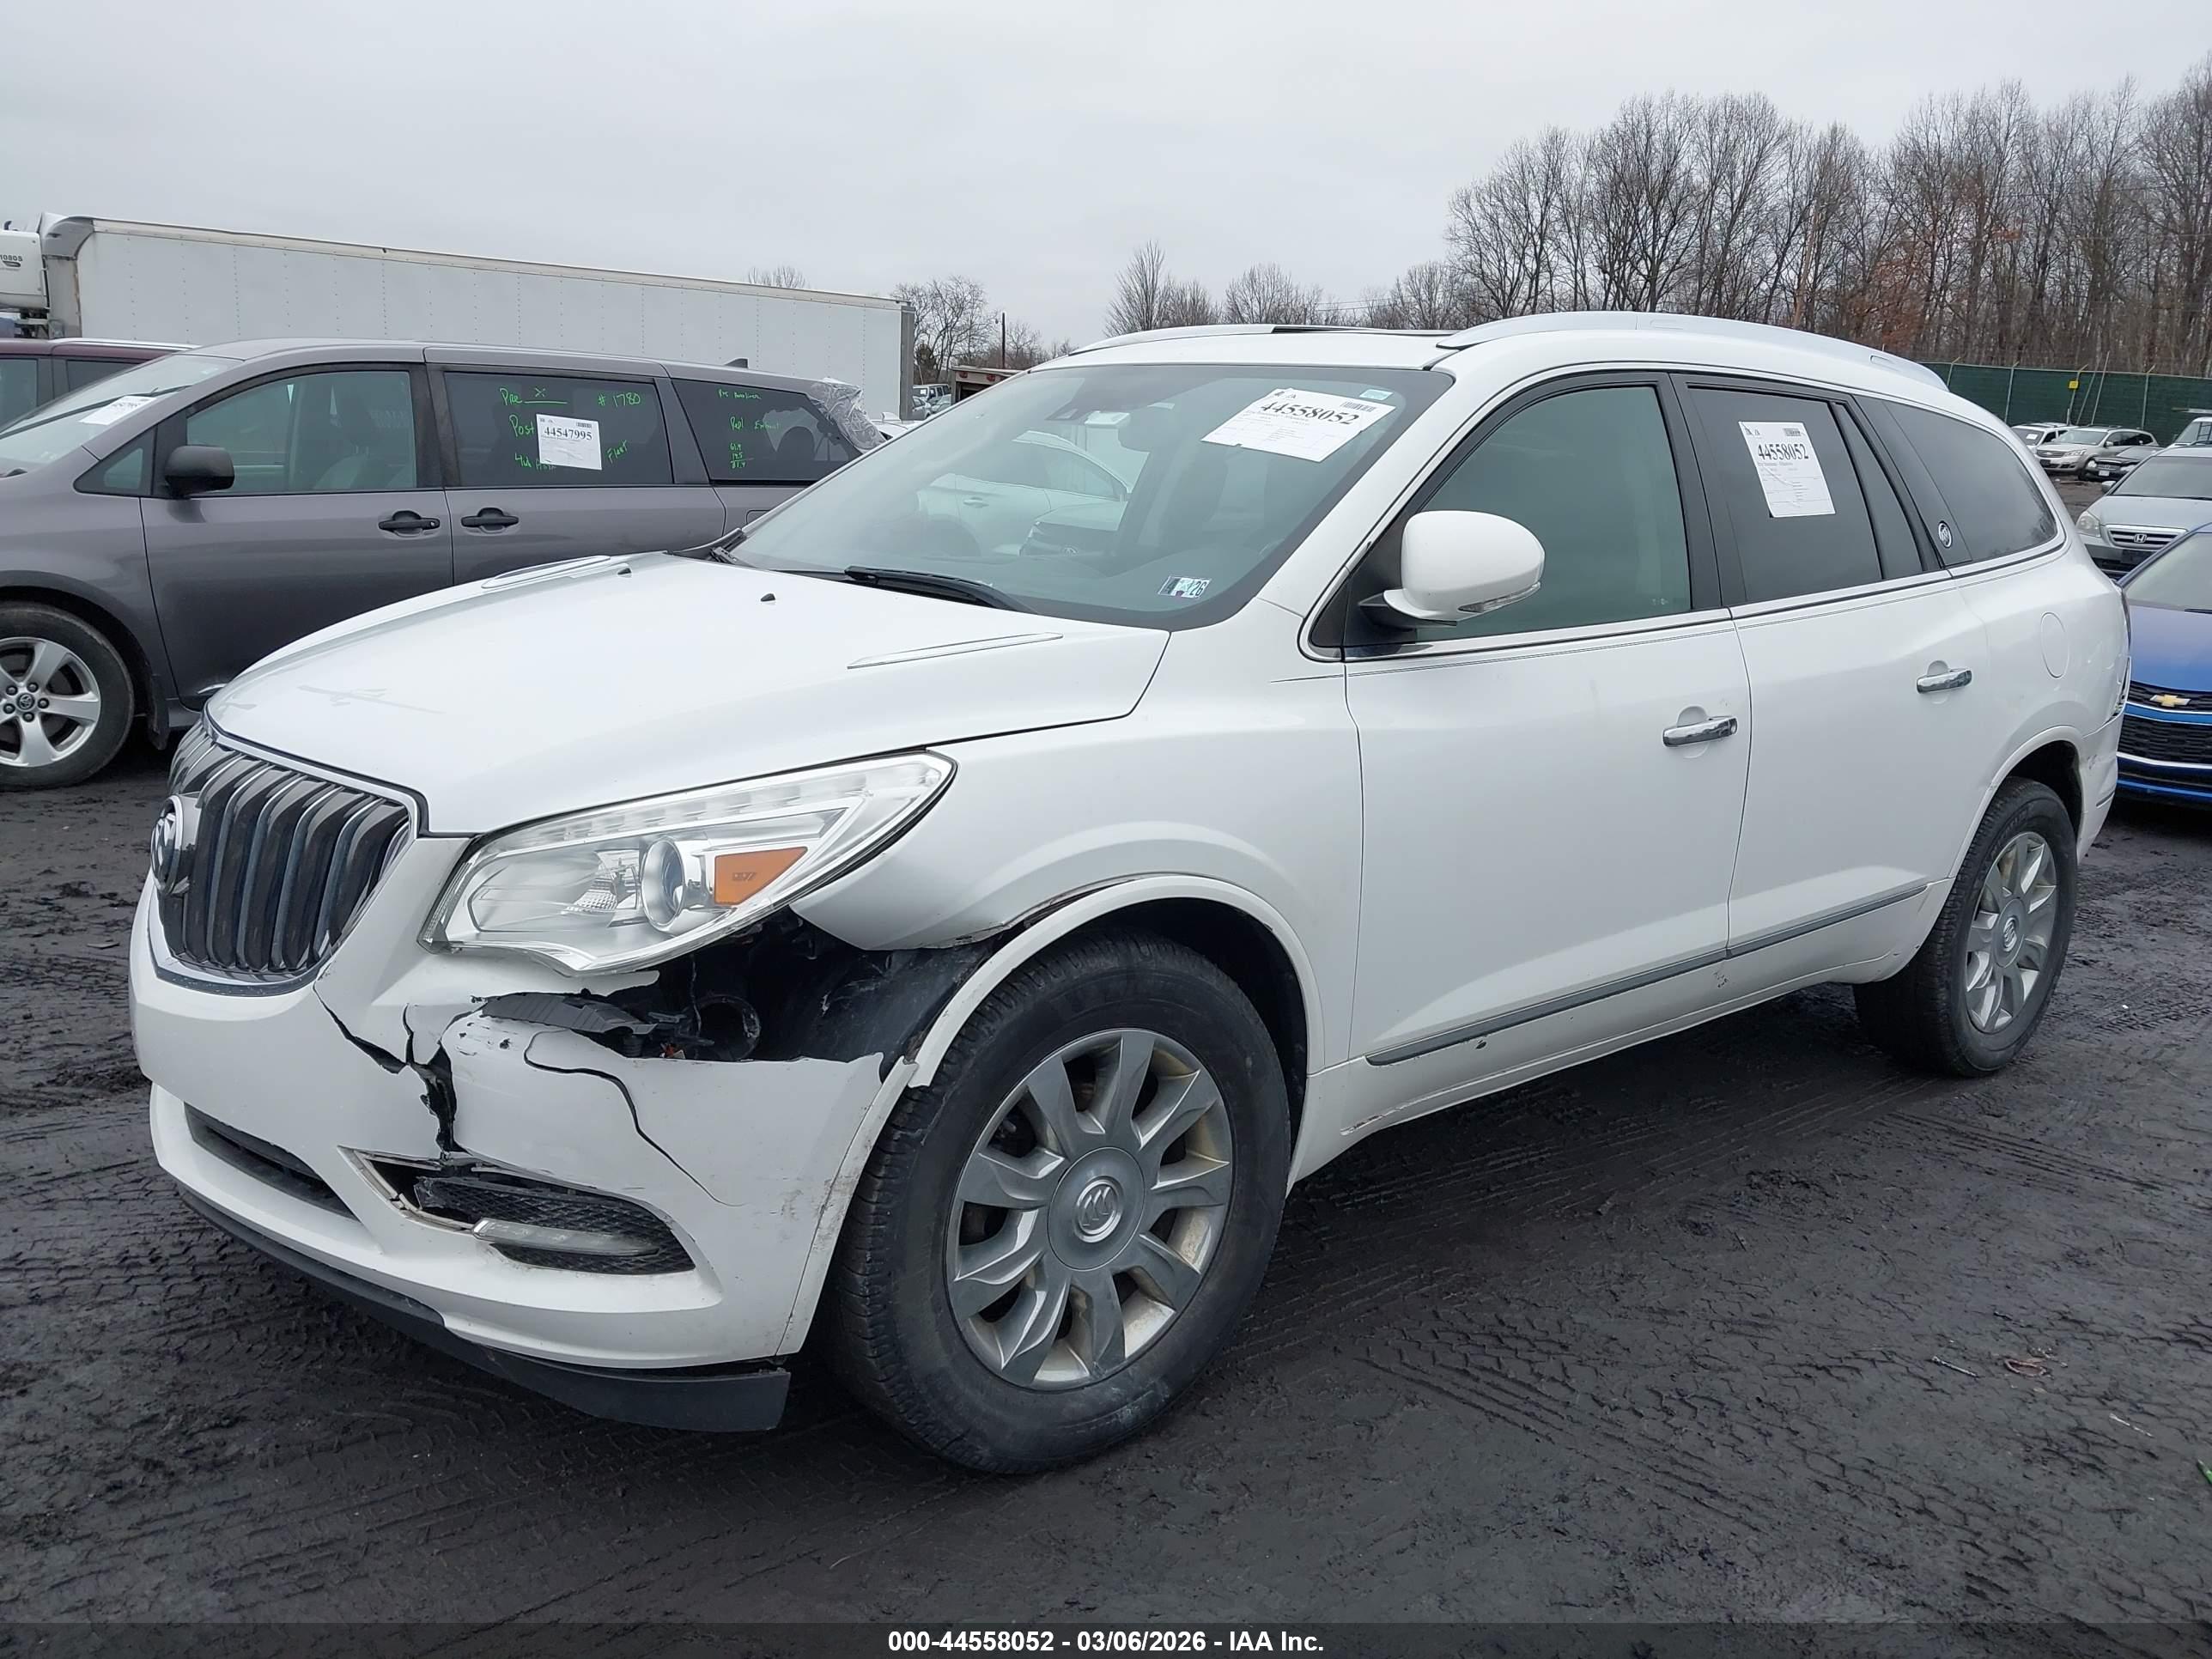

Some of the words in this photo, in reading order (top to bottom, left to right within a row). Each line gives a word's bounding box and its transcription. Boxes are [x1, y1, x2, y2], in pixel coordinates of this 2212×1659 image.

[613, 392, 641, 407] 1780
[1261, 401, 1360, 425] 44558052
[544, 426, 592, 441] 44547995
[1758, 443, 1809, 460] 44558052
